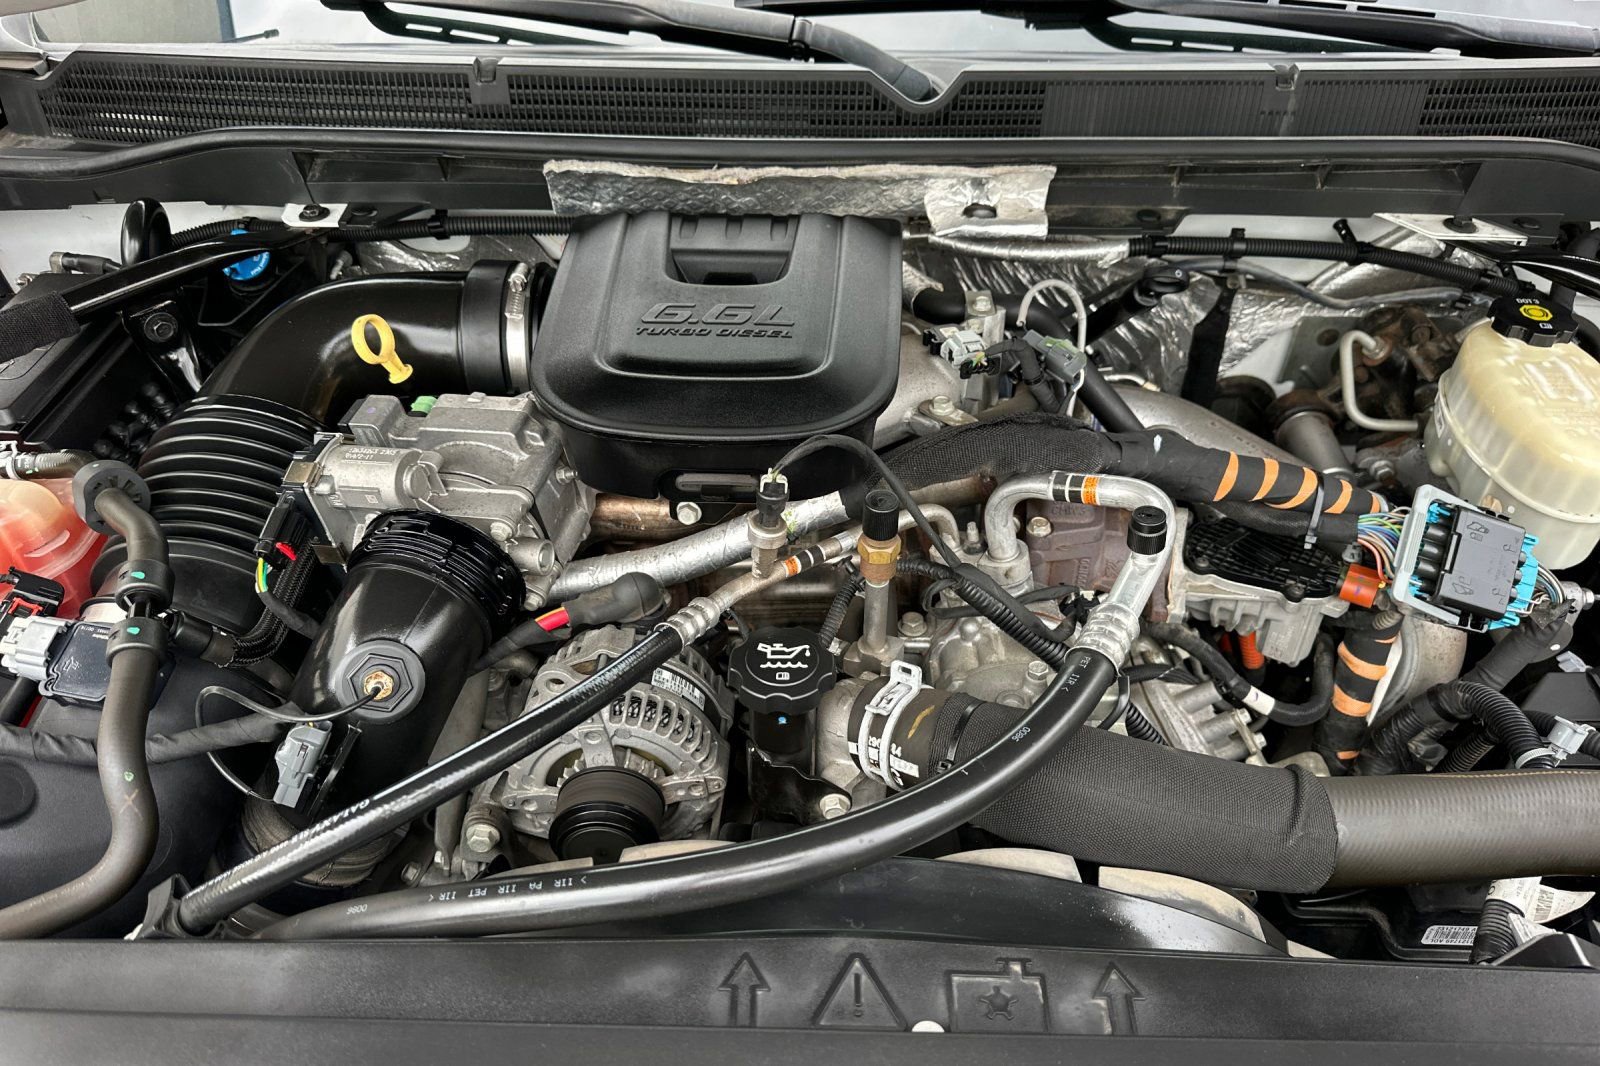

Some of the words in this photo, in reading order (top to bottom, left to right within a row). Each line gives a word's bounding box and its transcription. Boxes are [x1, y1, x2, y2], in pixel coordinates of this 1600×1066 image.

[641, 302, 795, 327] 6.6L
[636, 327, 712, 336] TURBO
[715, 328, 793, 338] DIESEL
[468, 886, 488, 898] PET
